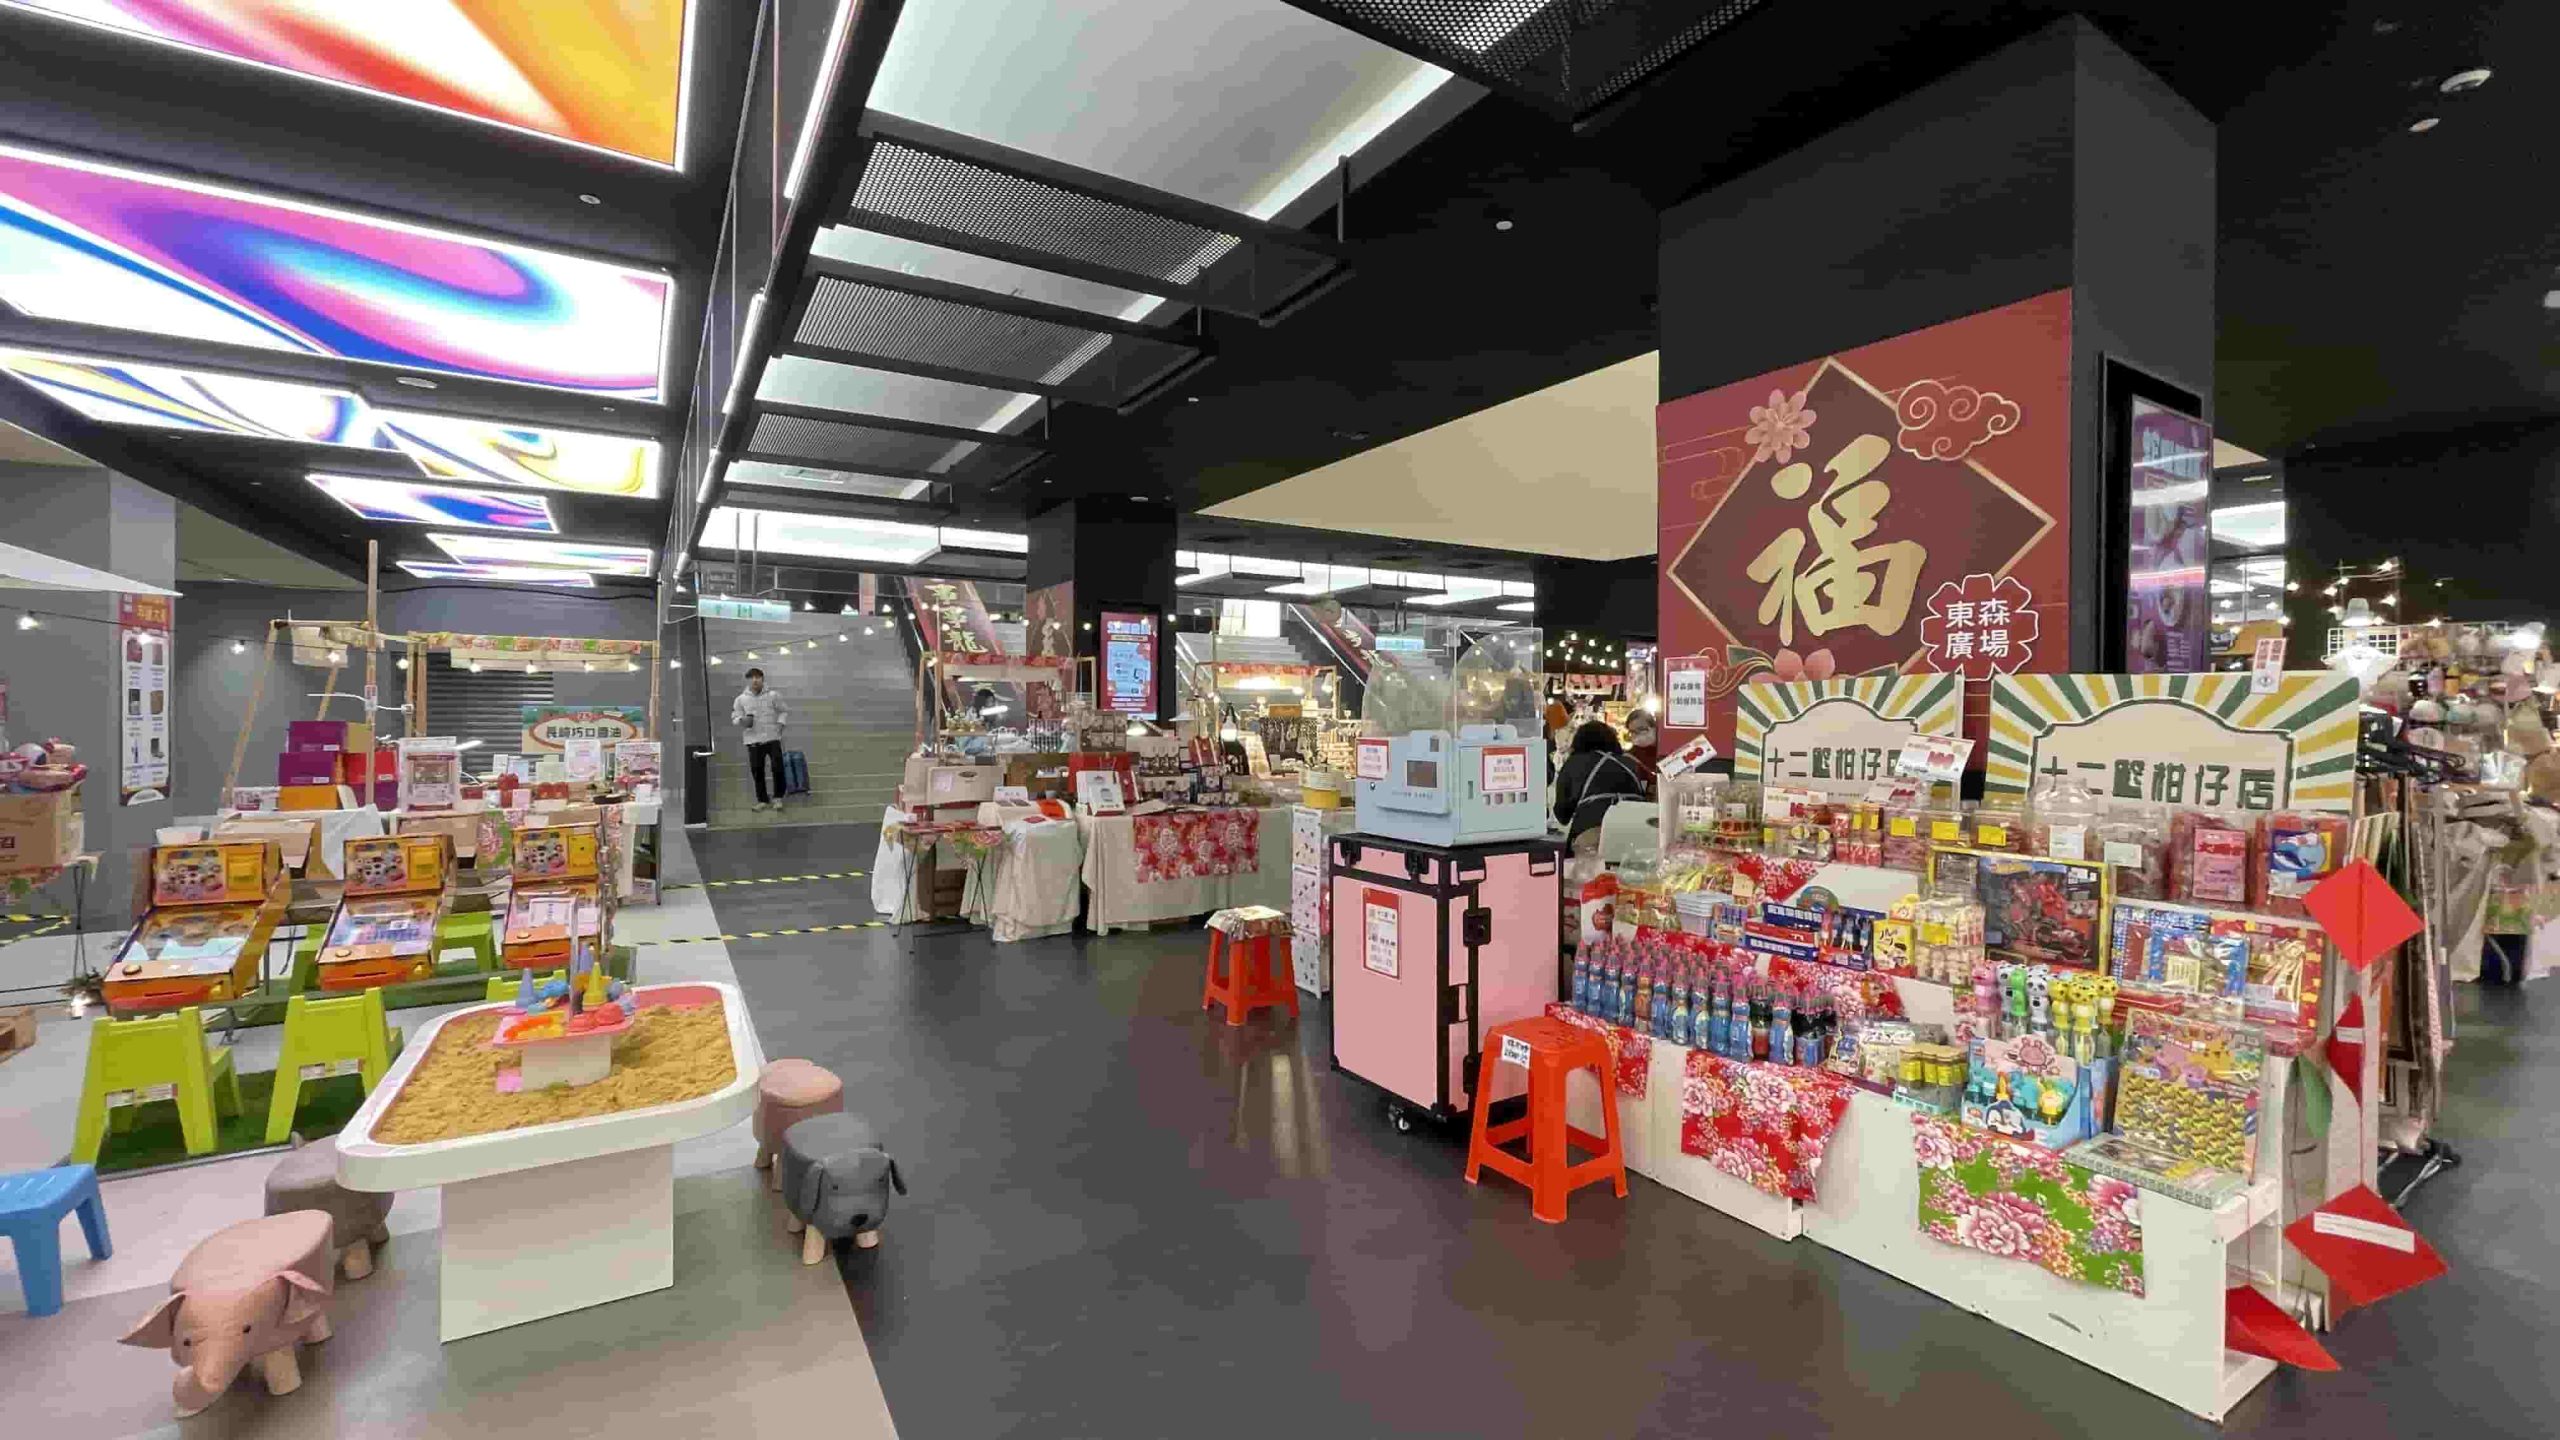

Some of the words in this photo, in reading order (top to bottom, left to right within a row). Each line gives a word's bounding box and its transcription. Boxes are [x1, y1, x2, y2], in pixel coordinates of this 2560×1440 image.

[1746, 433, 1927, 647] 福
[1945, 598, 2011, 628] 東森
[1945, 630, 2010, 660] 廣場
